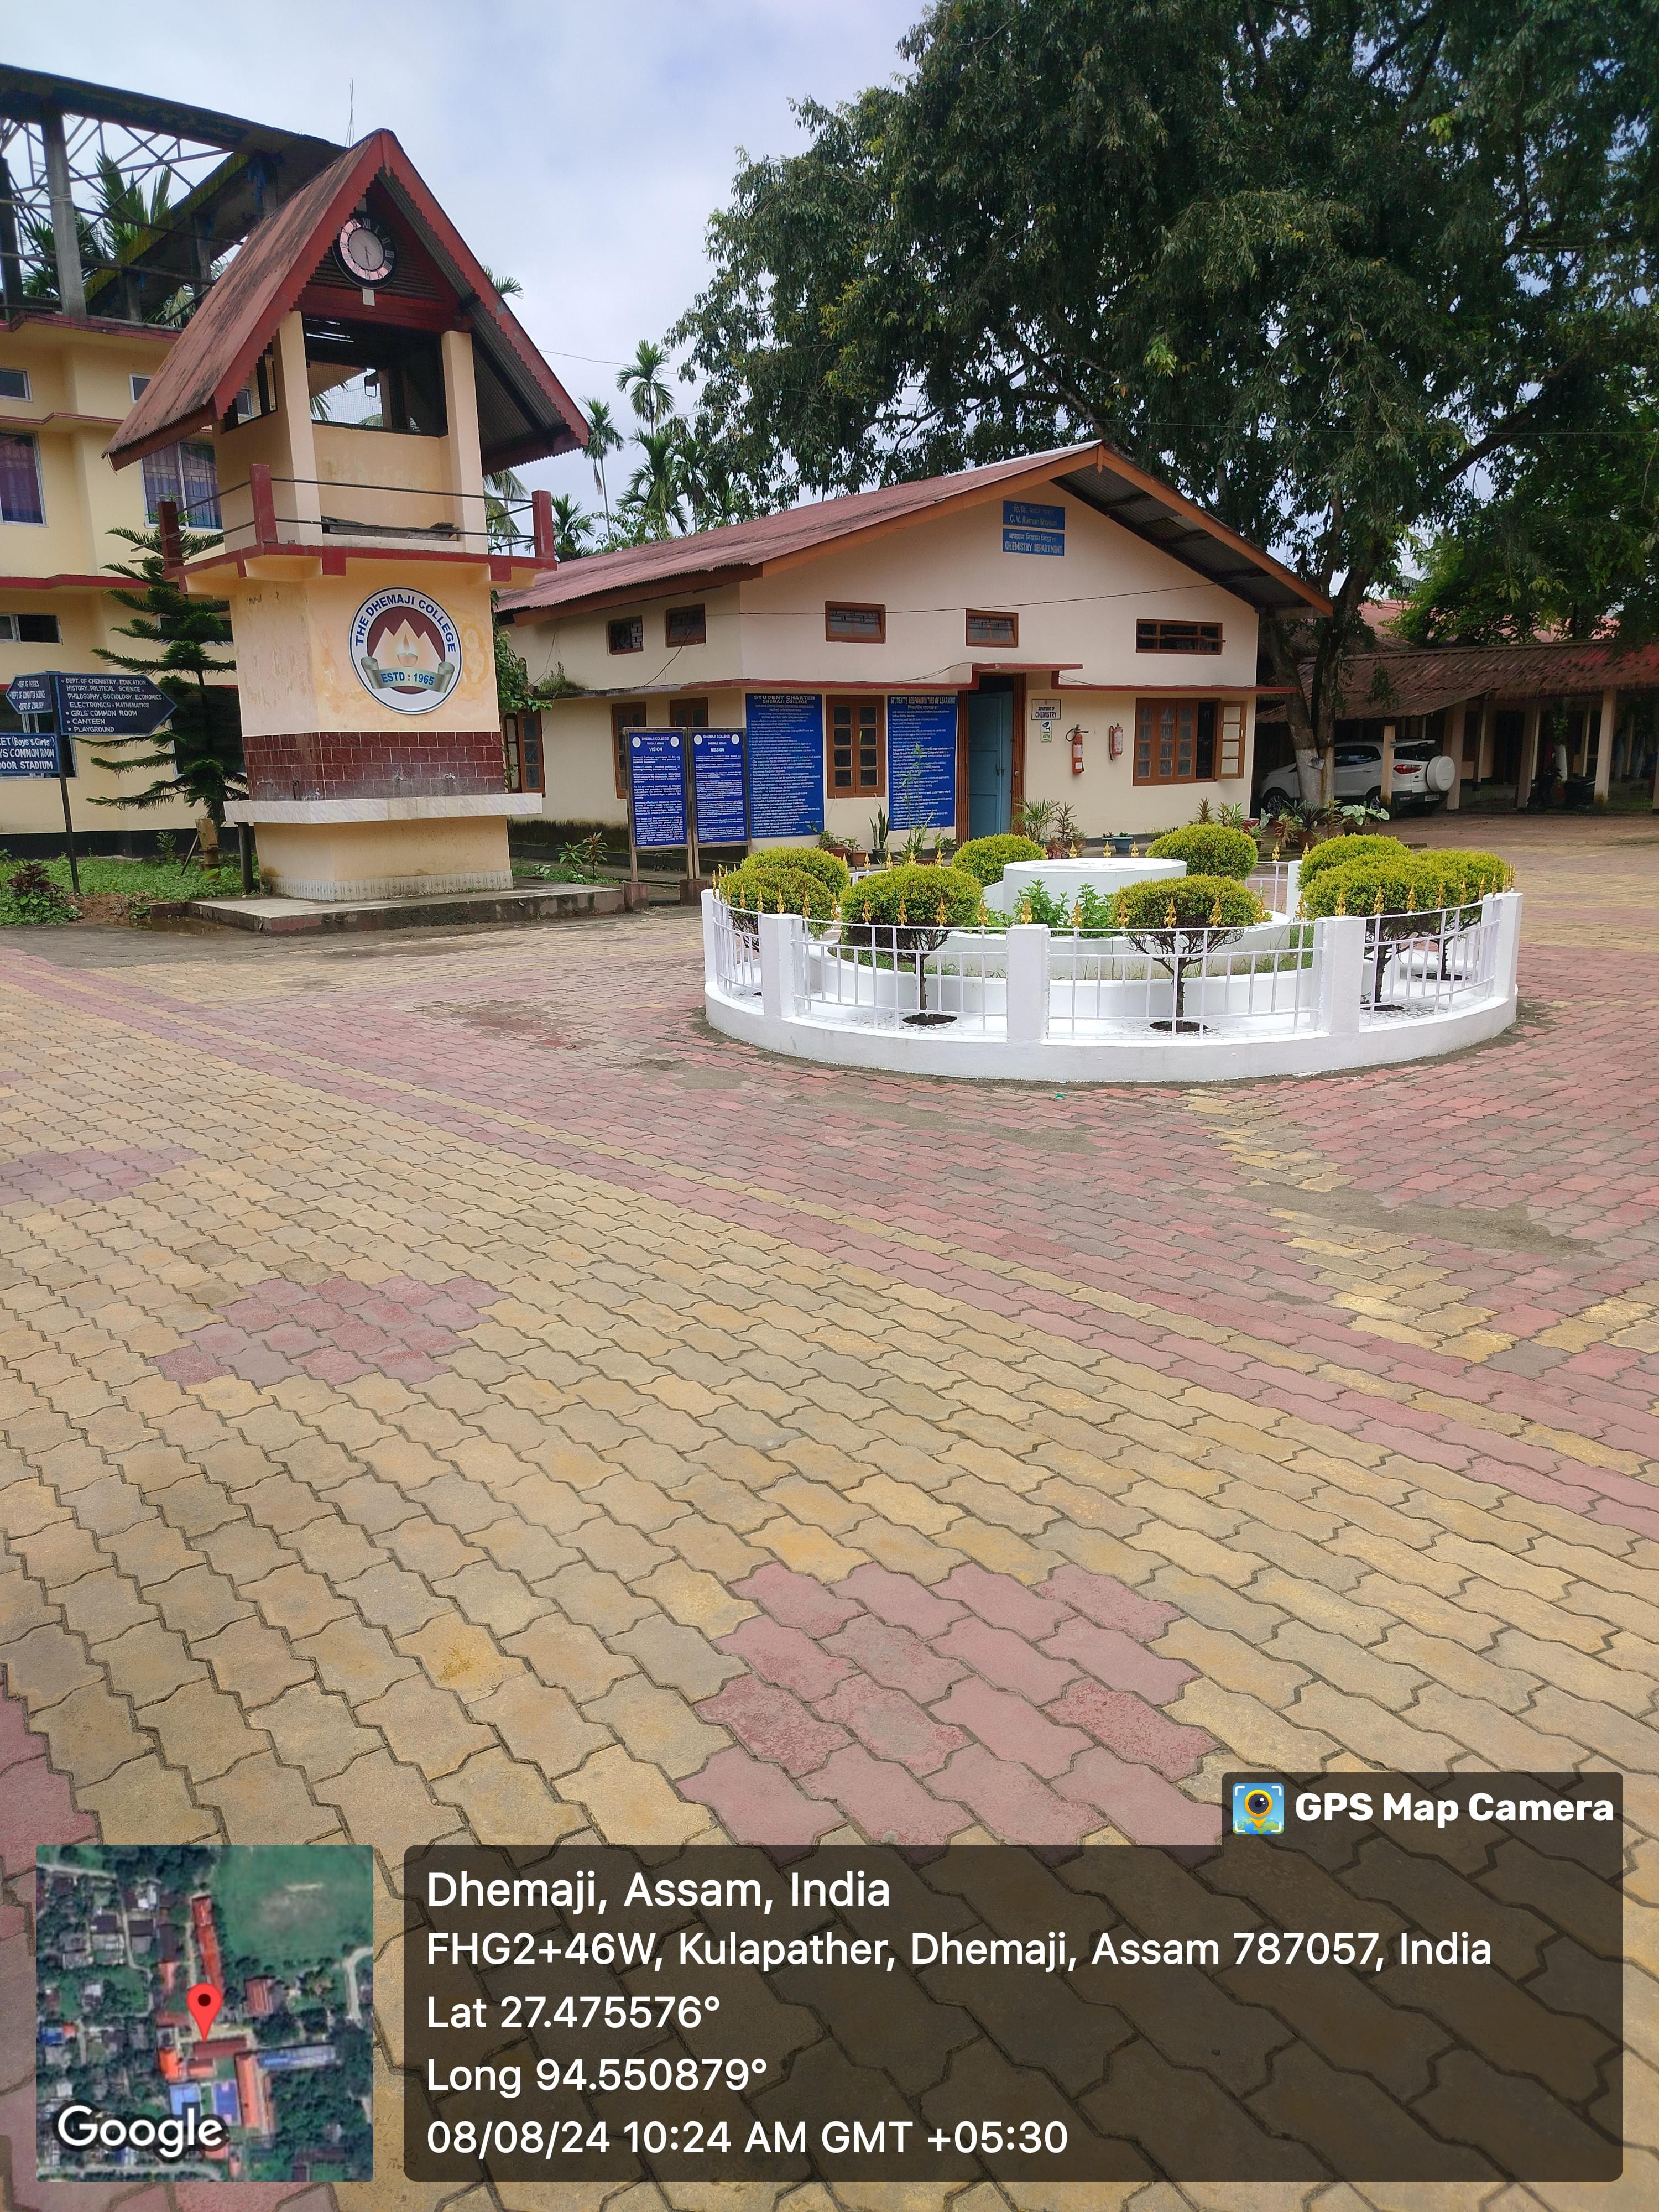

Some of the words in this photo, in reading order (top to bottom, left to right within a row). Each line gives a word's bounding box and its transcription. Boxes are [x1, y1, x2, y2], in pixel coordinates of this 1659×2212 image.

[1022, 515, 1040, 525] Raman
[1005, 541, 1032, 551] CHEMISTRY
[1034, 543, 1063, 554] DEPARTMENT
[356, 616, 369, 646] THE
[366, 594, 415, 618] DHEMAJI
[418, 599, 456, 653] COLLEGE
[380, 672, 405, 683] ESTD
[413, 673, 434, 685] 1965
[10, 748, 40, 758] COMMON
[40, 749, 54, 758] ROOM
[20, 760, 53, 769] STADIUM
